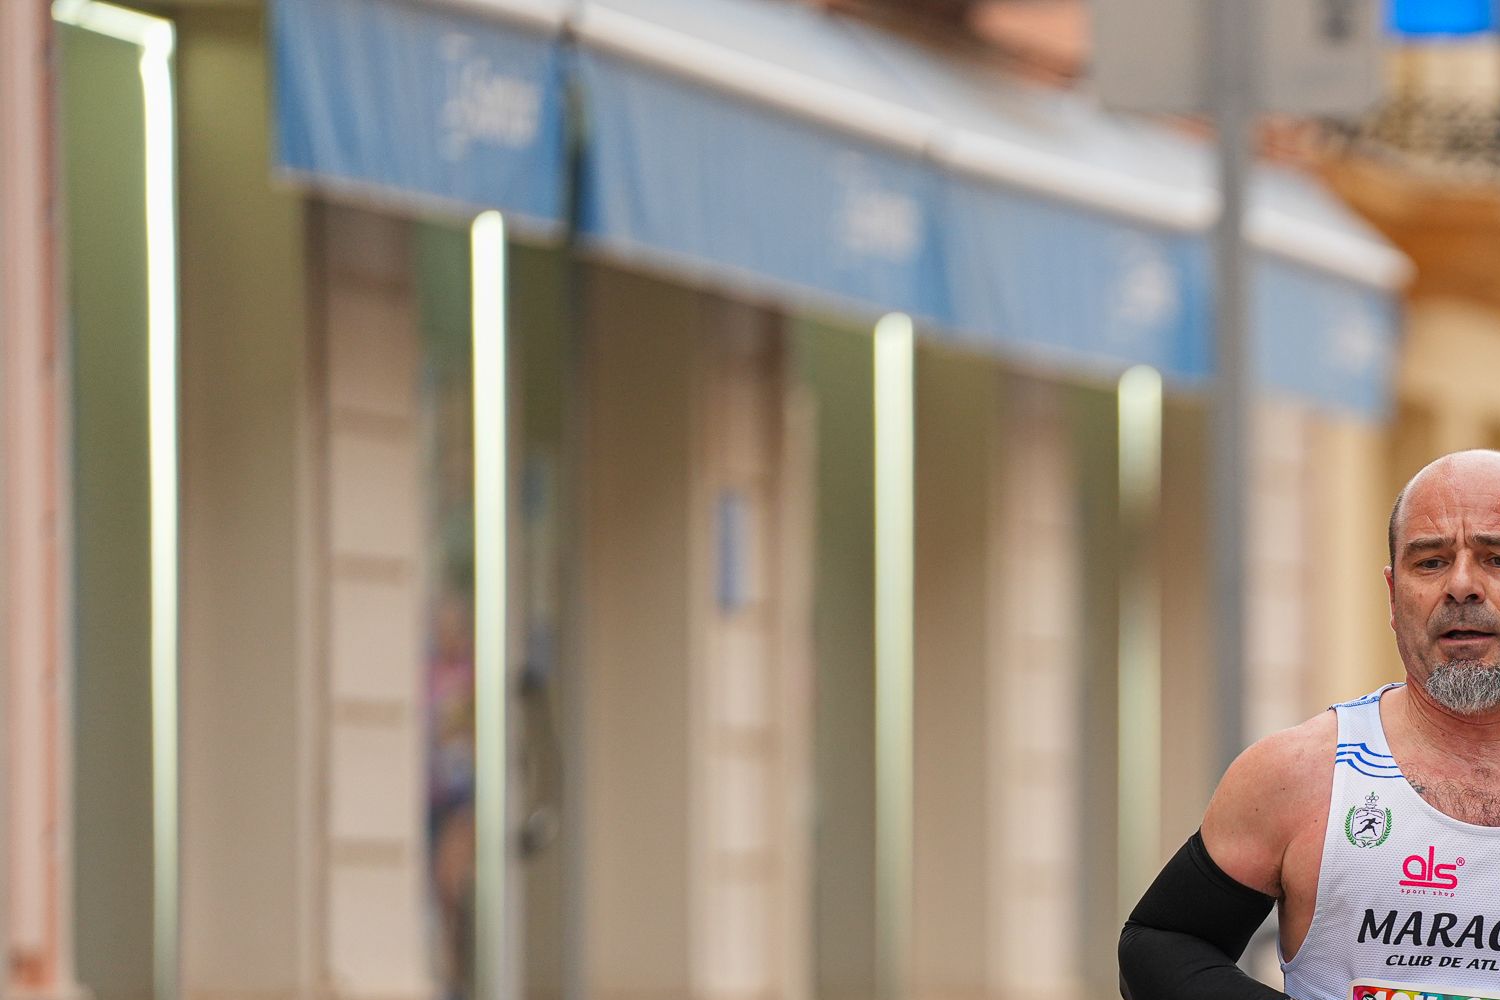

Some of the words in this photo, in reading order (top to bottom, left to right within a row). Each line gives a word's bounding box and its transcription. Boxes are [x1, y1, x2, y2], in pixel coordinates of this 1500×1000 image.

[1399, 846, 1458, 890] als
[1385, 954, 1433, 967] CLUB
[1438, 956, 1463, 968] DE
